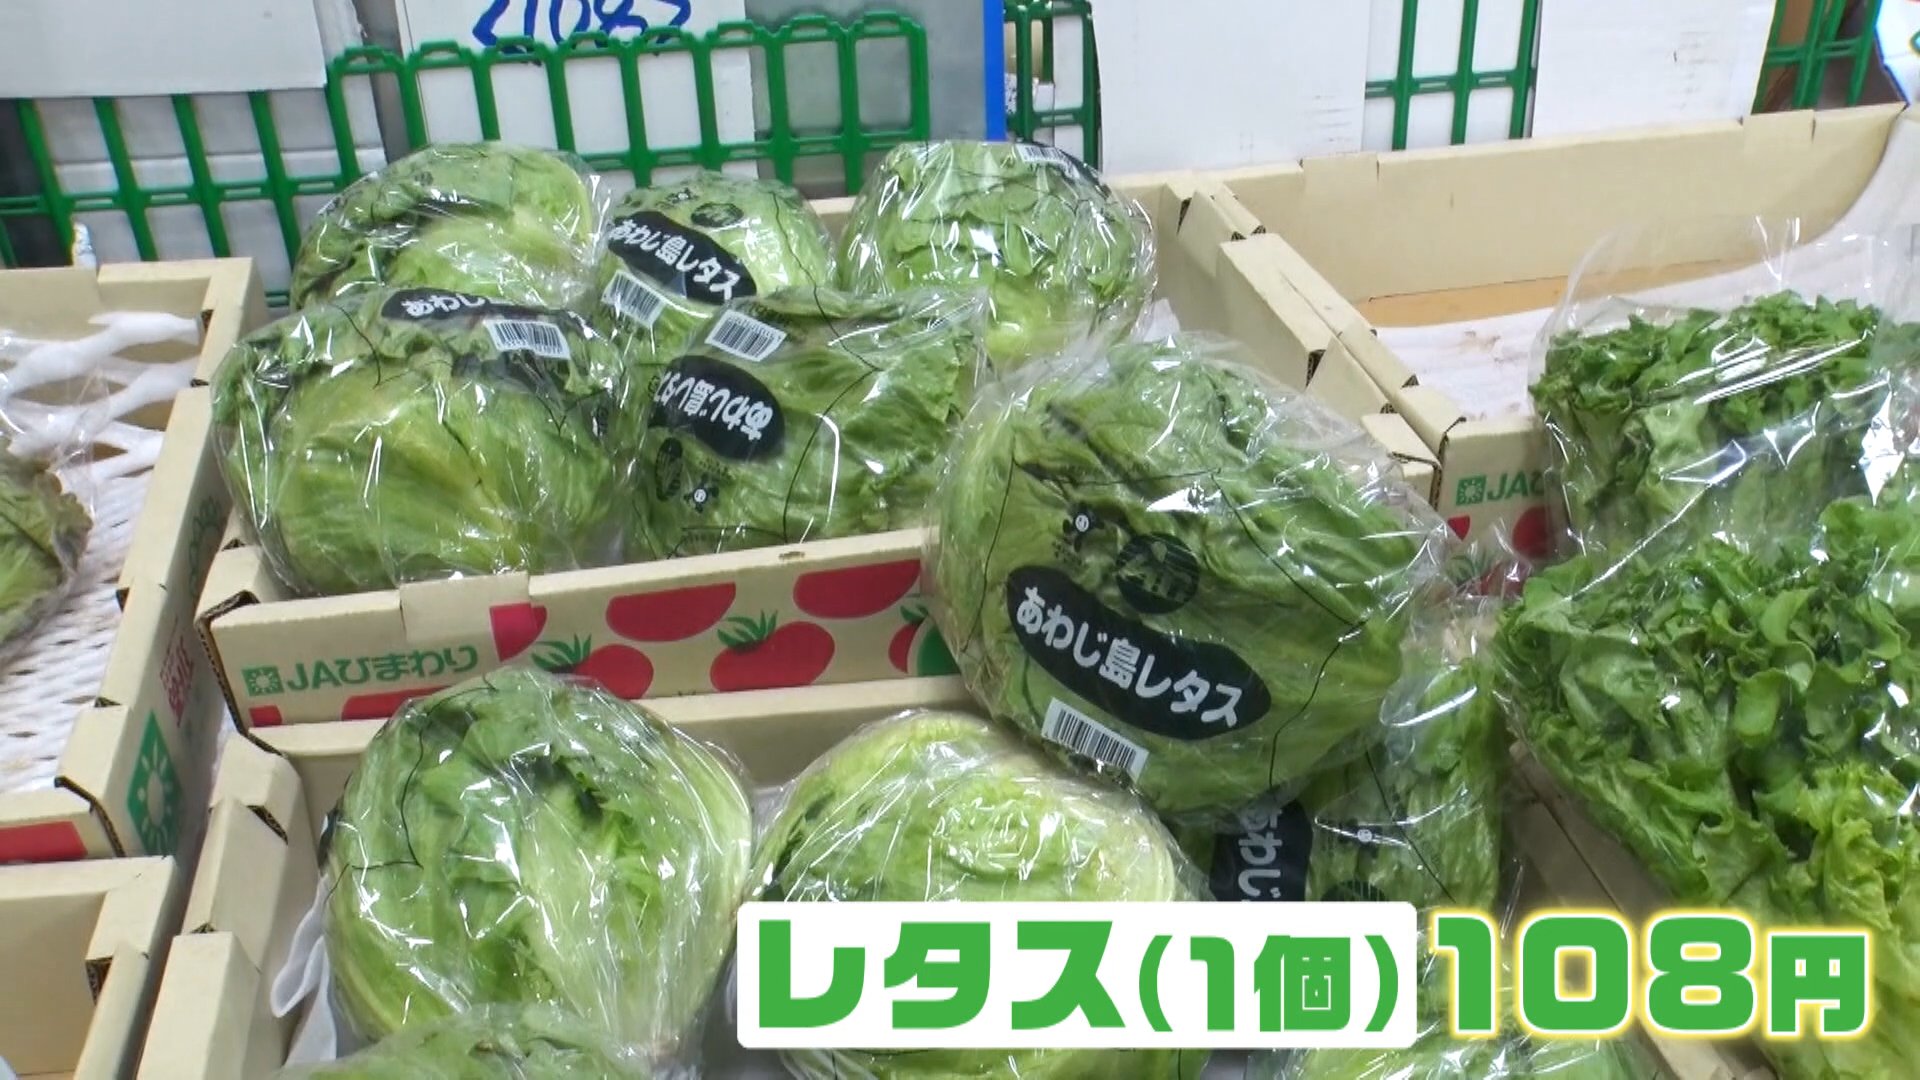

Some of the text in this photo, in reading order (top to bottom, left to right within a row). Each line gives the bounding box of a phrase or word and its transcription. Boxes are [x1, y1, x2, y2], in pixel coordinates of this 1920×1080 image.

[607, 218, 741, 301] あわじ島レタス
[286, 645, 479, 692] JAひまわり
[1016, 585, 1243, 728] あわじ島レタス
